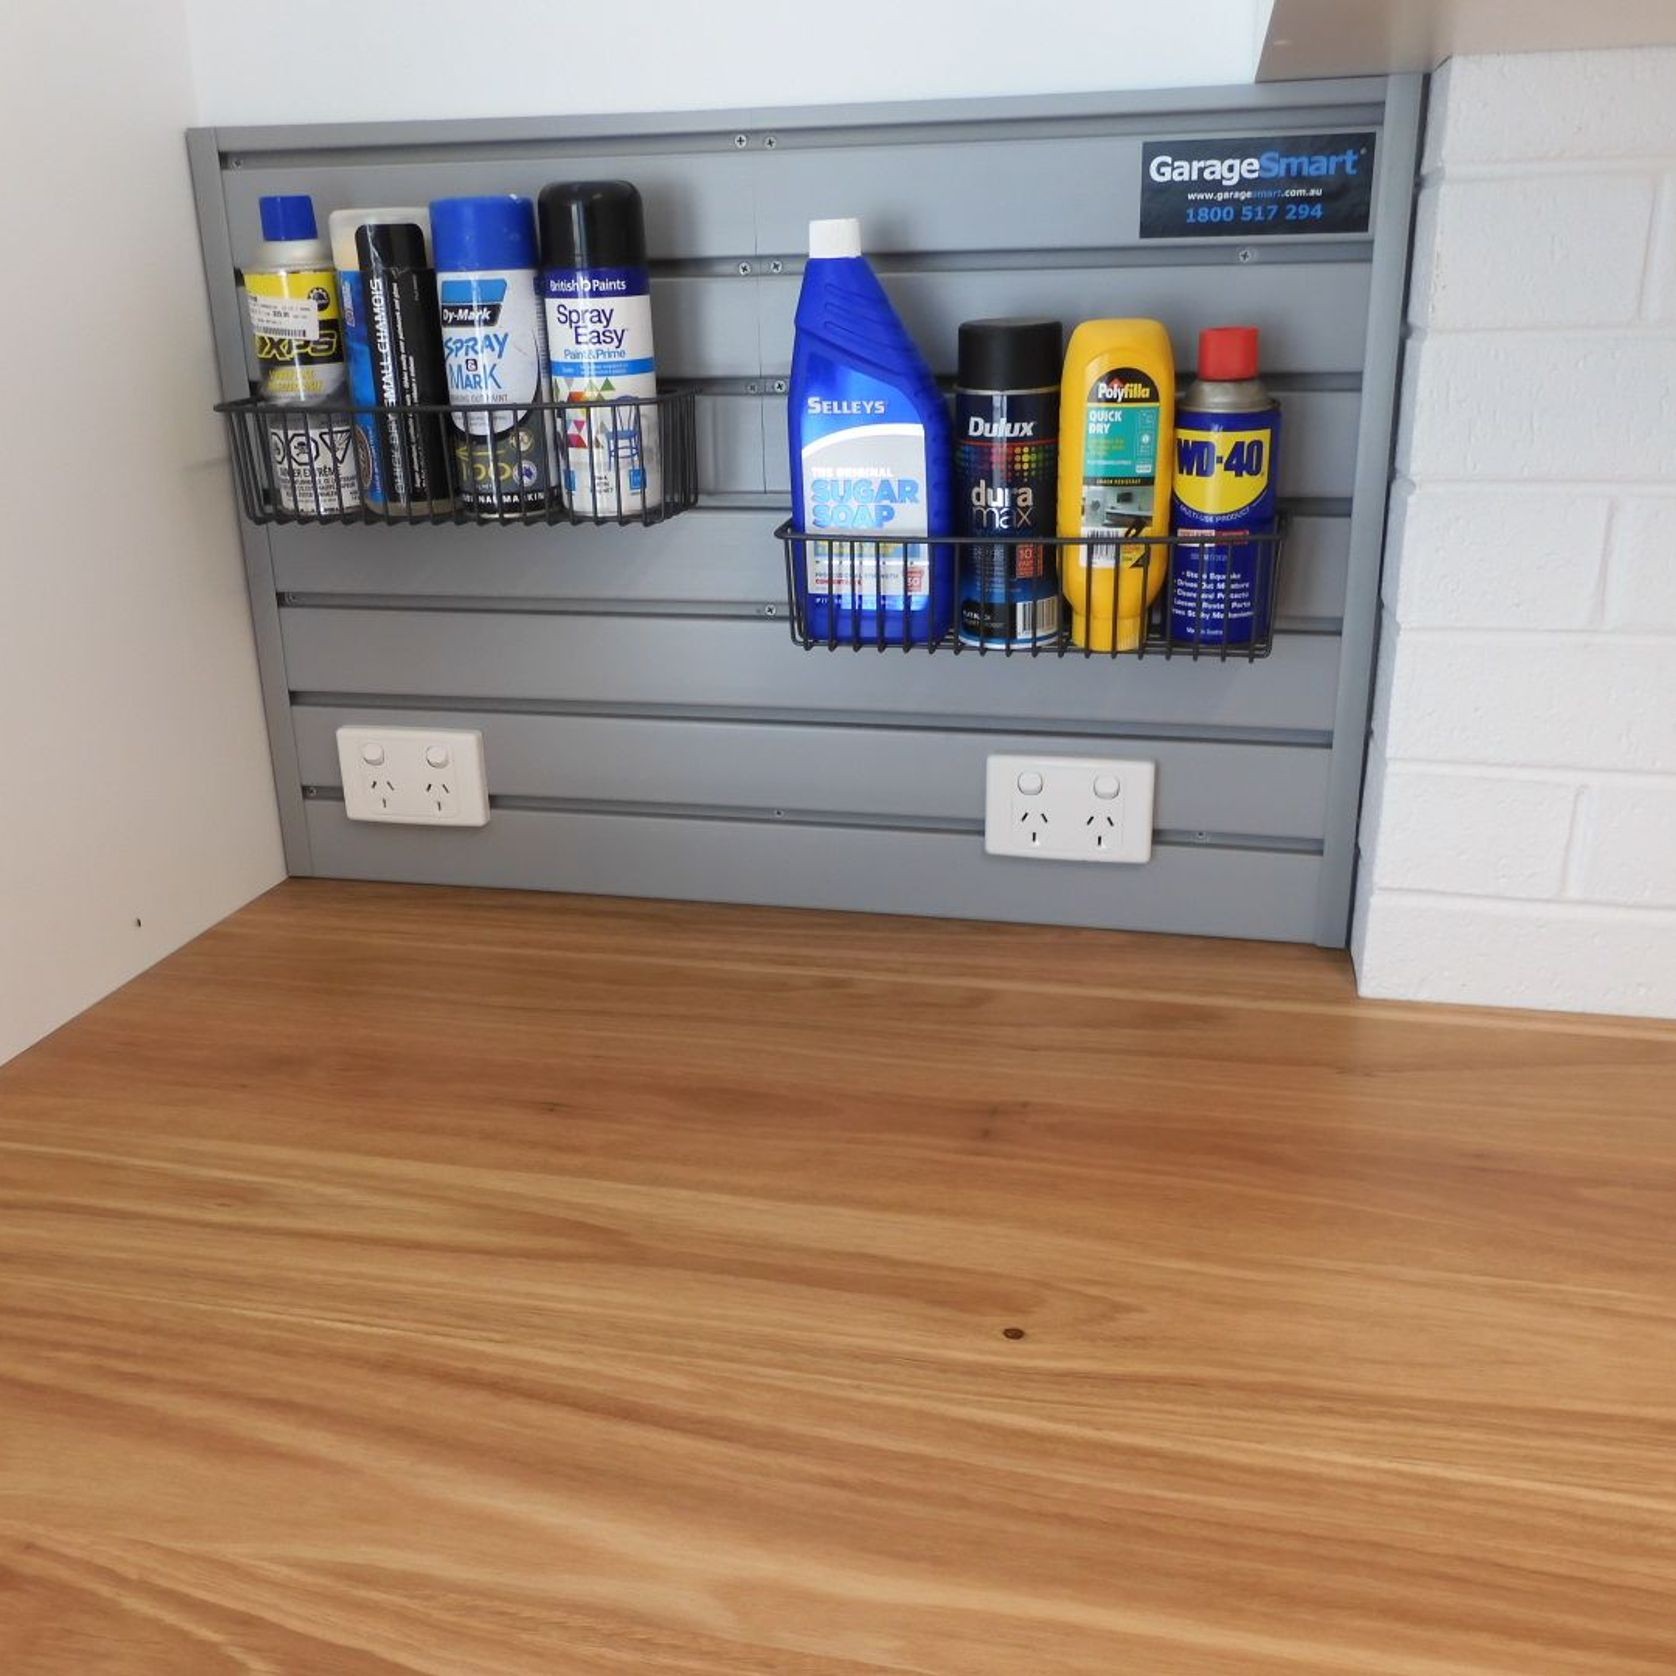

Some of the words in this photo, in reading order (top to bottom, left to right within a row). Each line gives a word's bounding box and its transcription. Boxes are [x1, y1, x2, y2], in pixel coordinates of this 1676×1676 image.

[1149, 148, 1358, 186] GarageSmart
[1187, 187, 1322, 201] www.garagesmart.com.au
[1186, 205, 1234, 223] 1800
[1241, 204, 1278, 222] 517
[1285, 203, 1323, 221] 294
[550, 279, 579, 293] British
[592, 278, 627, 292] Paints
[369, 277, 389, 354] CHAMOIS
[442, 303, 492, 323] Dy-Mark
[556, 304, 614, 329] Spray
[444, 332, 509, 360] SPRAY
[574, 325, 626, 348] Easy
[595, 347, 626, 359] Prime
[1097, 382, 1150, 403] Polyfilla
[807, 396, 886, 414] SELLEYS
[968, 416, 1034, 438] Dulux
[1089, 410, 1123, 423] QUICK
[1088, 422, 1111, 434] DRY
[1177, 437, 1264, 478] WD-40
[811, 478, 920, 504] SUGAR
[971, 479, 1034, 508] dura
[812, 504, 896, 529] SOAP
